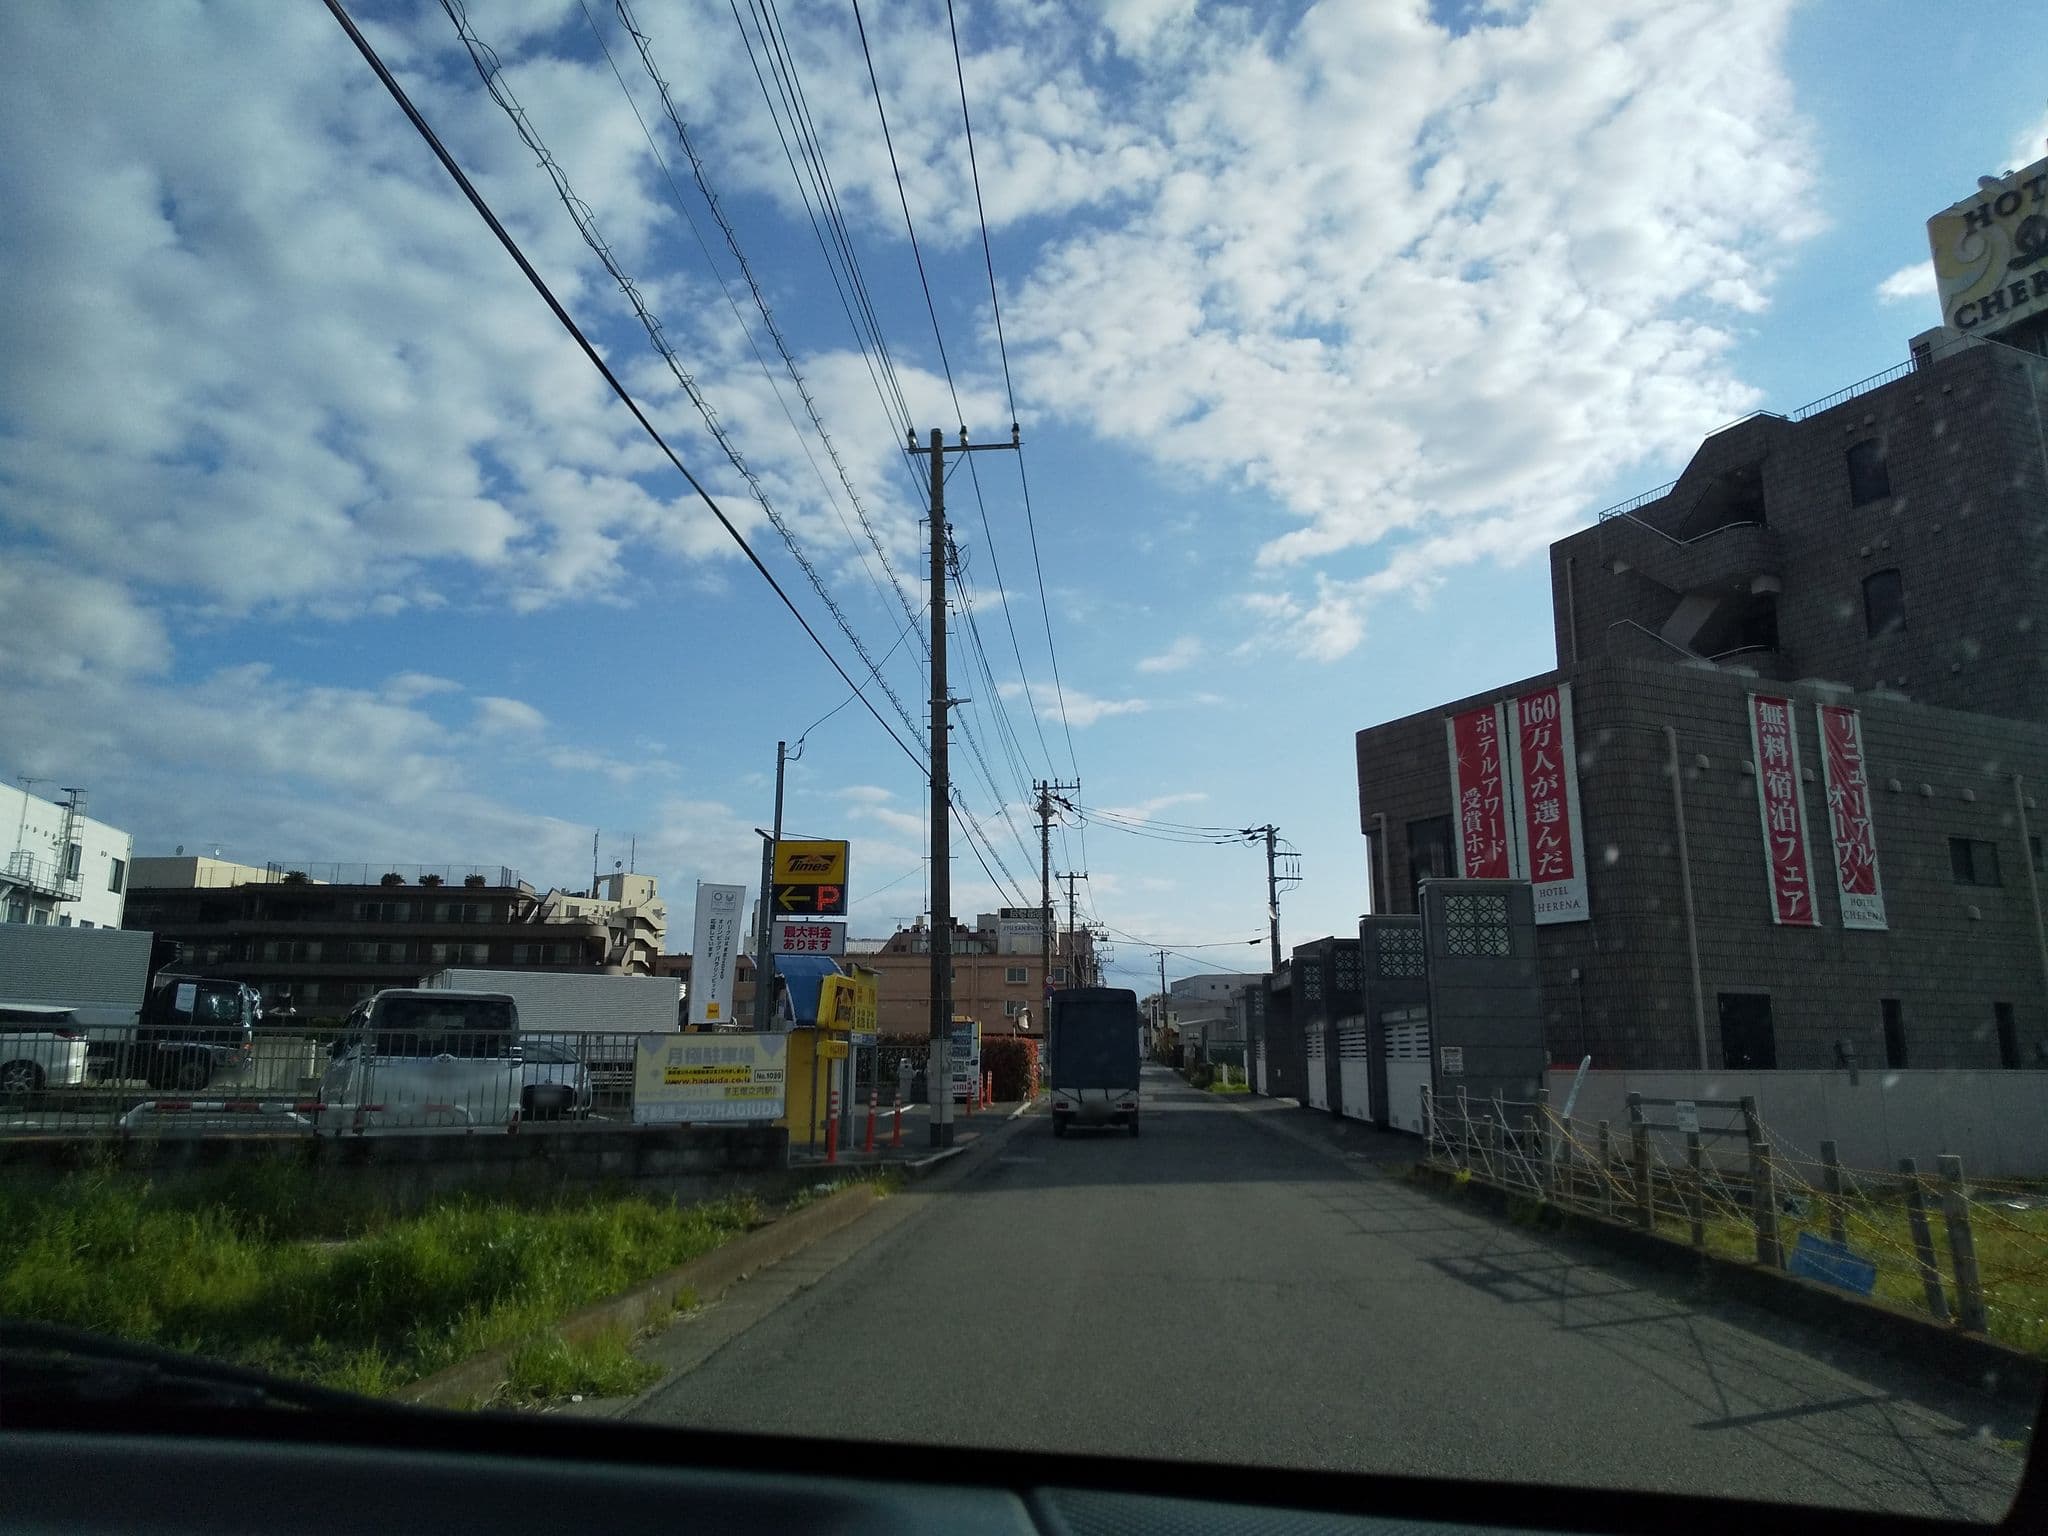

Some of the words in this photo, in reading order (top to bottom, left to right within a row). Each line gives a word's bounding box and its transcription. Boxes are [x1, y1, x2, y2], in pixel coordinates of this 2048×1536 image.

[1476, 714, 1505, 861] ホテルアワード
[1521, 695, 1564, 876] 160万人が選んだ
[1760, 703, 1803, 916] 無料宿泊フェア
[1840, 715, 1876, 867] リニューアル
[1463, 788, 1486, 879] 受賞ホテ
[1828, 784, 1858, 892] オープン
[787, 855, 836, 873] Times
[1539, 886, 1568, 898] HOTEL
[817, 885, 840, 911] P
[1536, 899, 1582, 912] HERENA
[784, 926, 832, 938] 最大料金
[784, 939, 831, 951] あります
